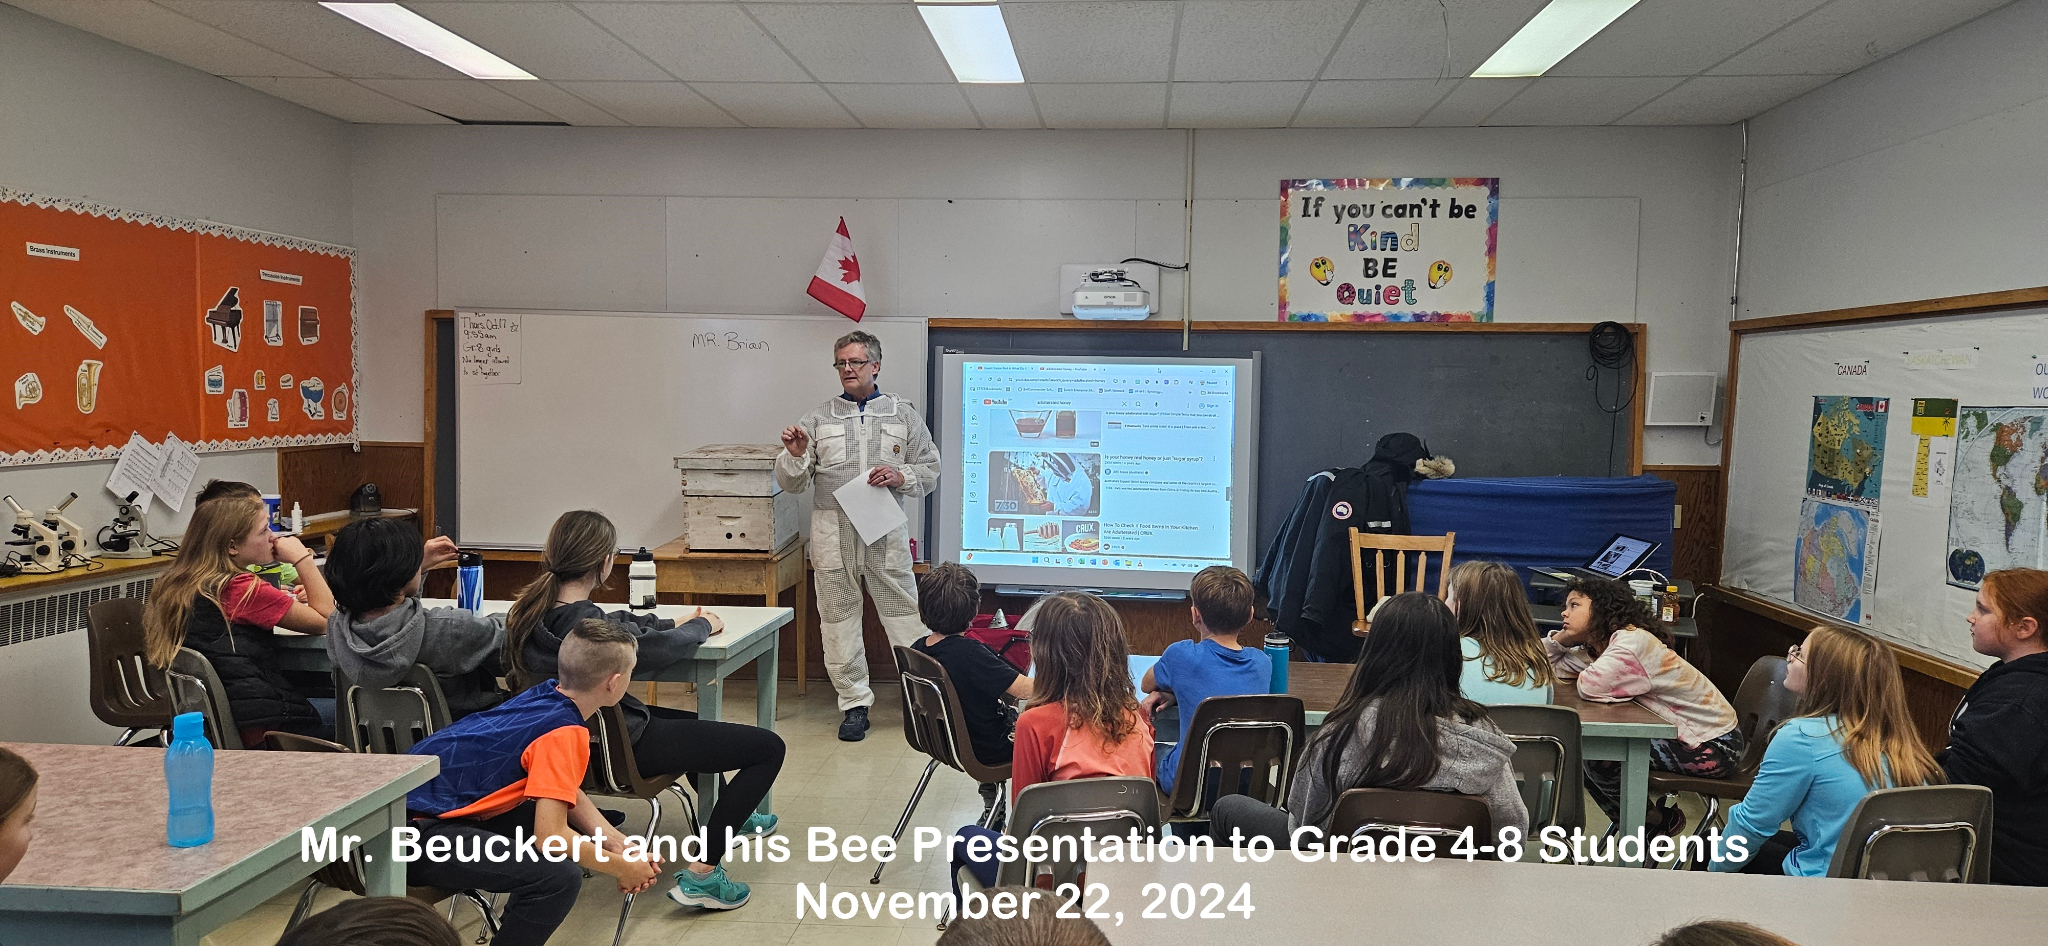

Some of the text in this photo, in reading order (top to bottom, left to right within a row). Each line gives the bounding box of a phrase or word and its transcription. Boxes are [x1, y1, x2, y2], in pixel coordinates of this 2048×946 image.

[1301, 196, 1477, 224] If you can't be
[1347, 222, 1419, 251] Kind
[29, 245, 76, 258] Brass Instruments
[1363, 257, 1397, 278] BE
[1336, 278, 1417, 305] Quiet
[723, 332, 770, 351] Brian
[1837, 364, 1867, 376] CANADA
[1906, 354, 1972, 366] SASKATCHEWAN
